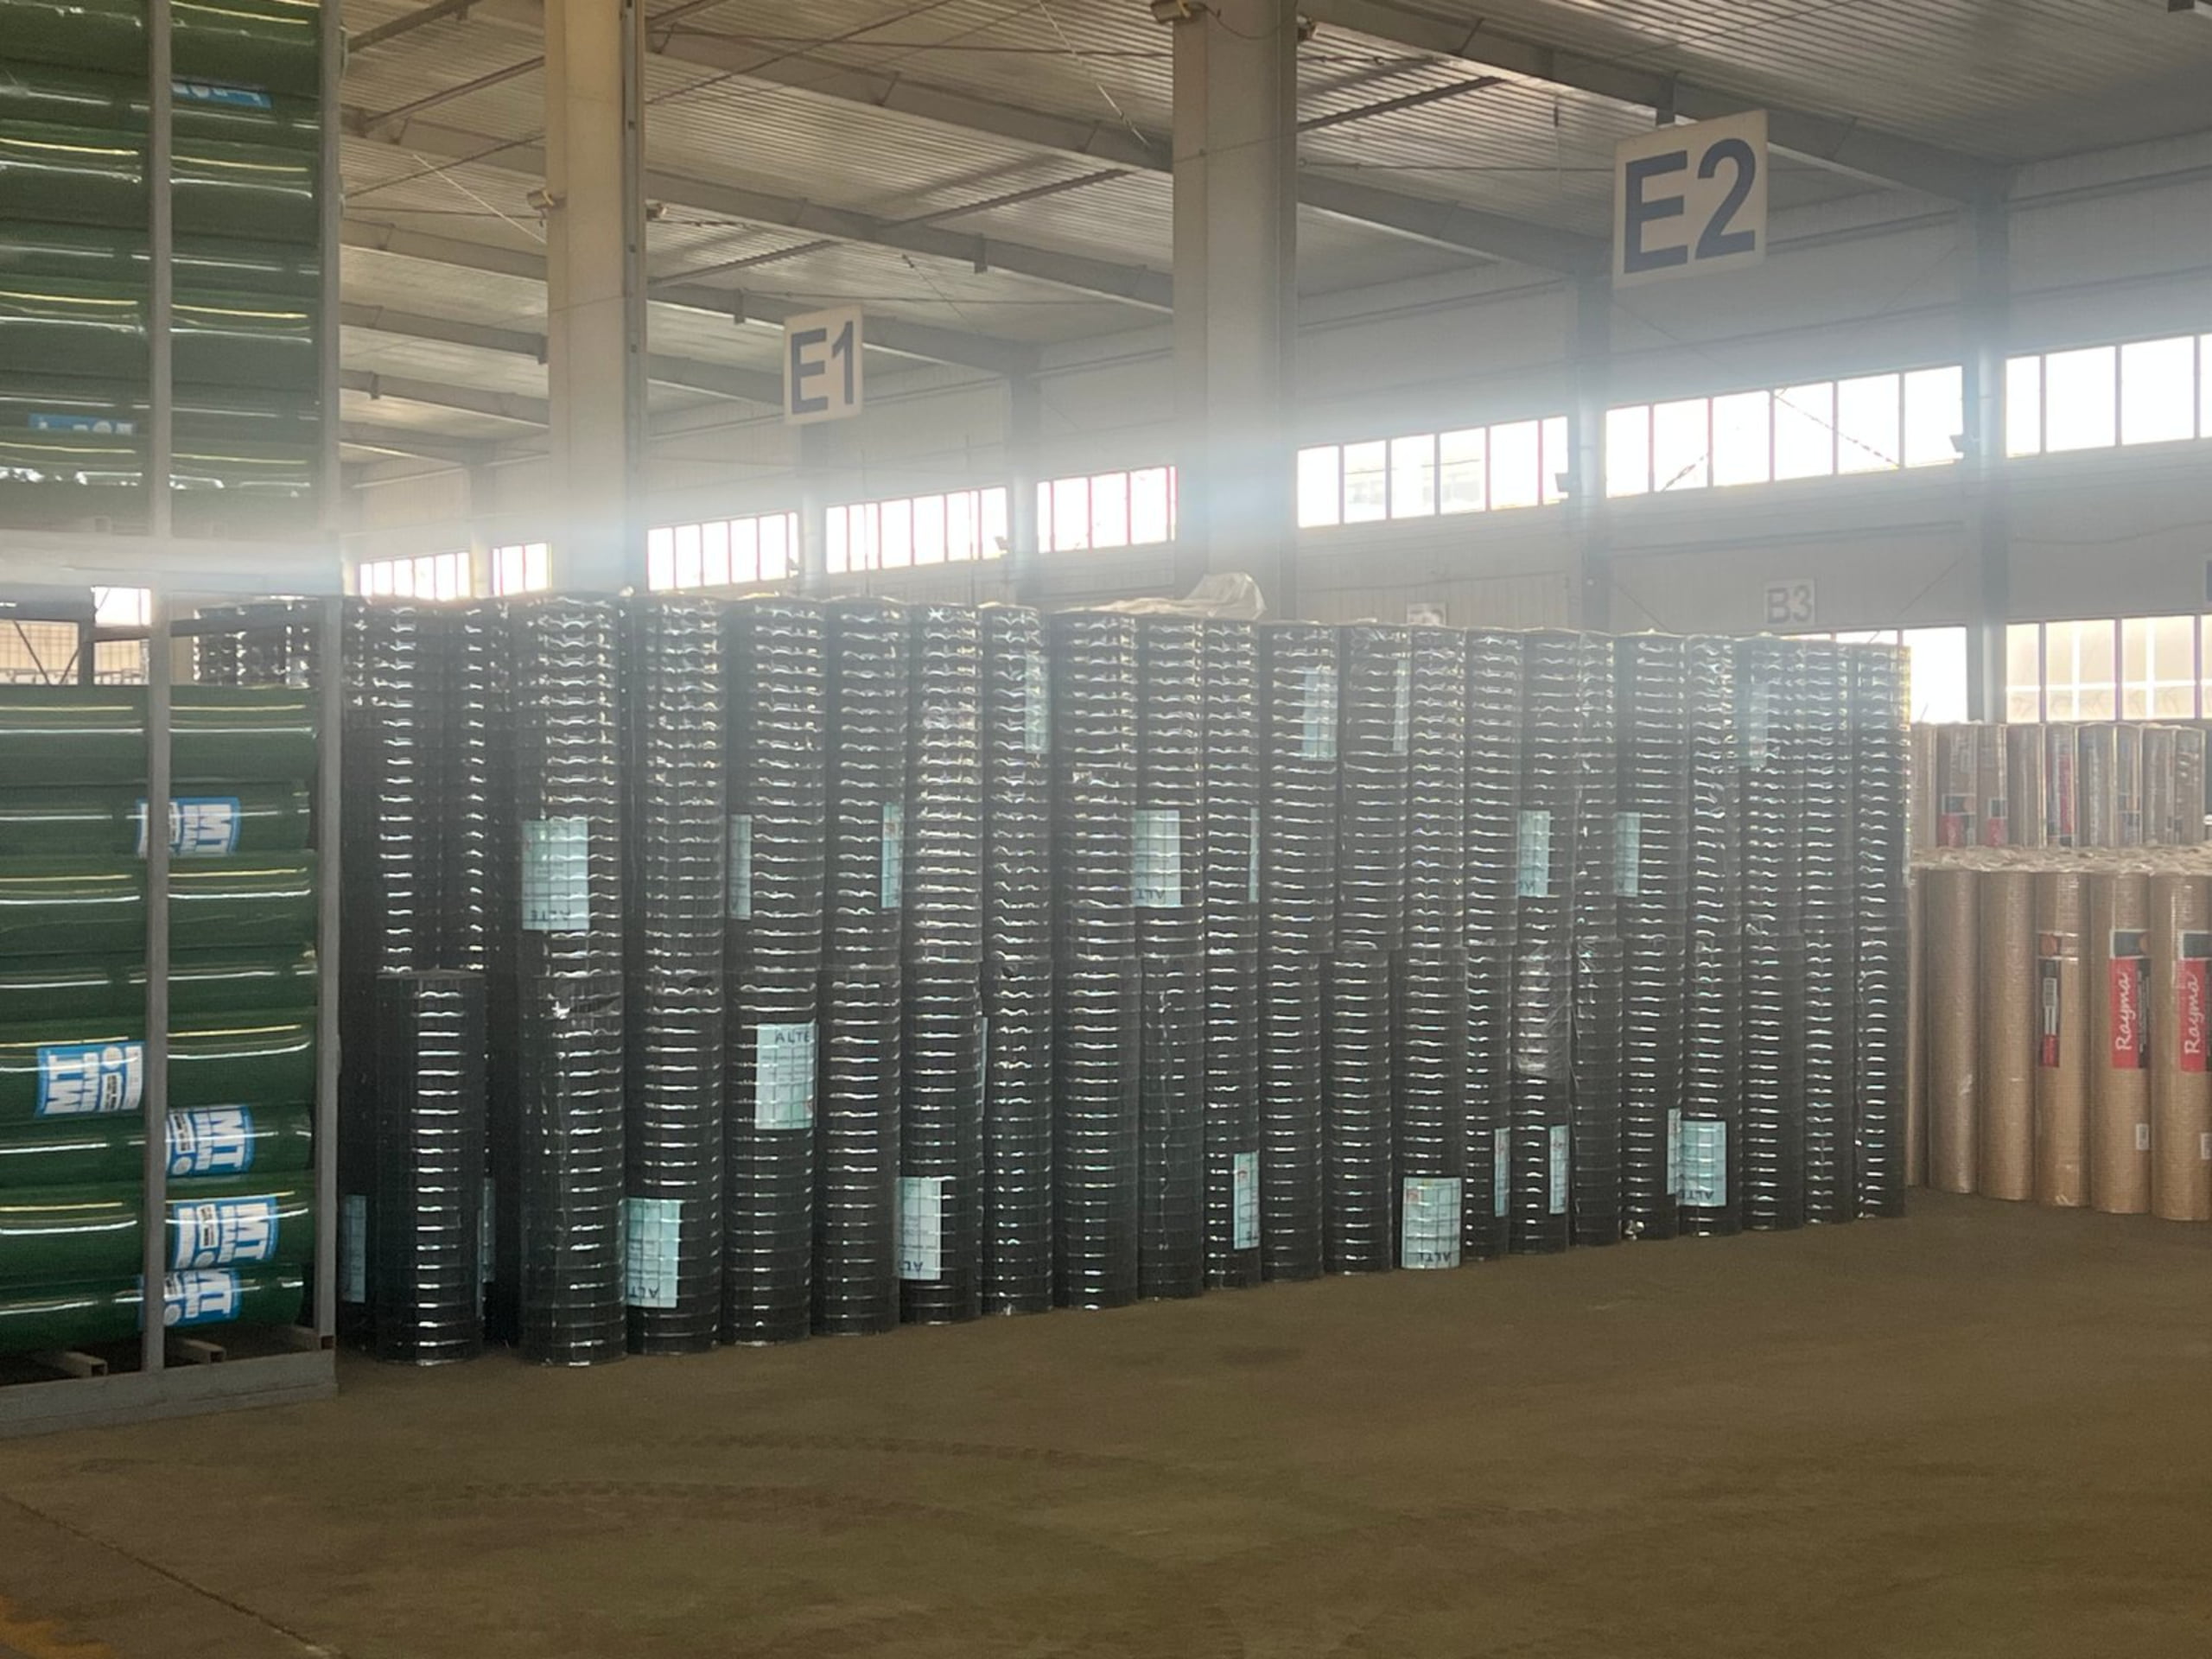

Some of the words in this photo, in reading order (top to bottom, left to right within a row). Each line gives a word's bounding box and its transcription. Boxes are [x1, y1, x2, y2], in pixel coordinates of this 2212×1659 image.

[1624, 137, 1756, 275] E2
[791, 320, 854, 416] E1
[1767, 585, 1812, 623] B3
[2115, 971, 2136, 1051] Rayma
[2184, 972, 2204, 1055] Rayma
[43, 1055, 84, 1115] MT
[208, 1109, 245, 1168] MT
[233, 1203, 270, 1261] MT
